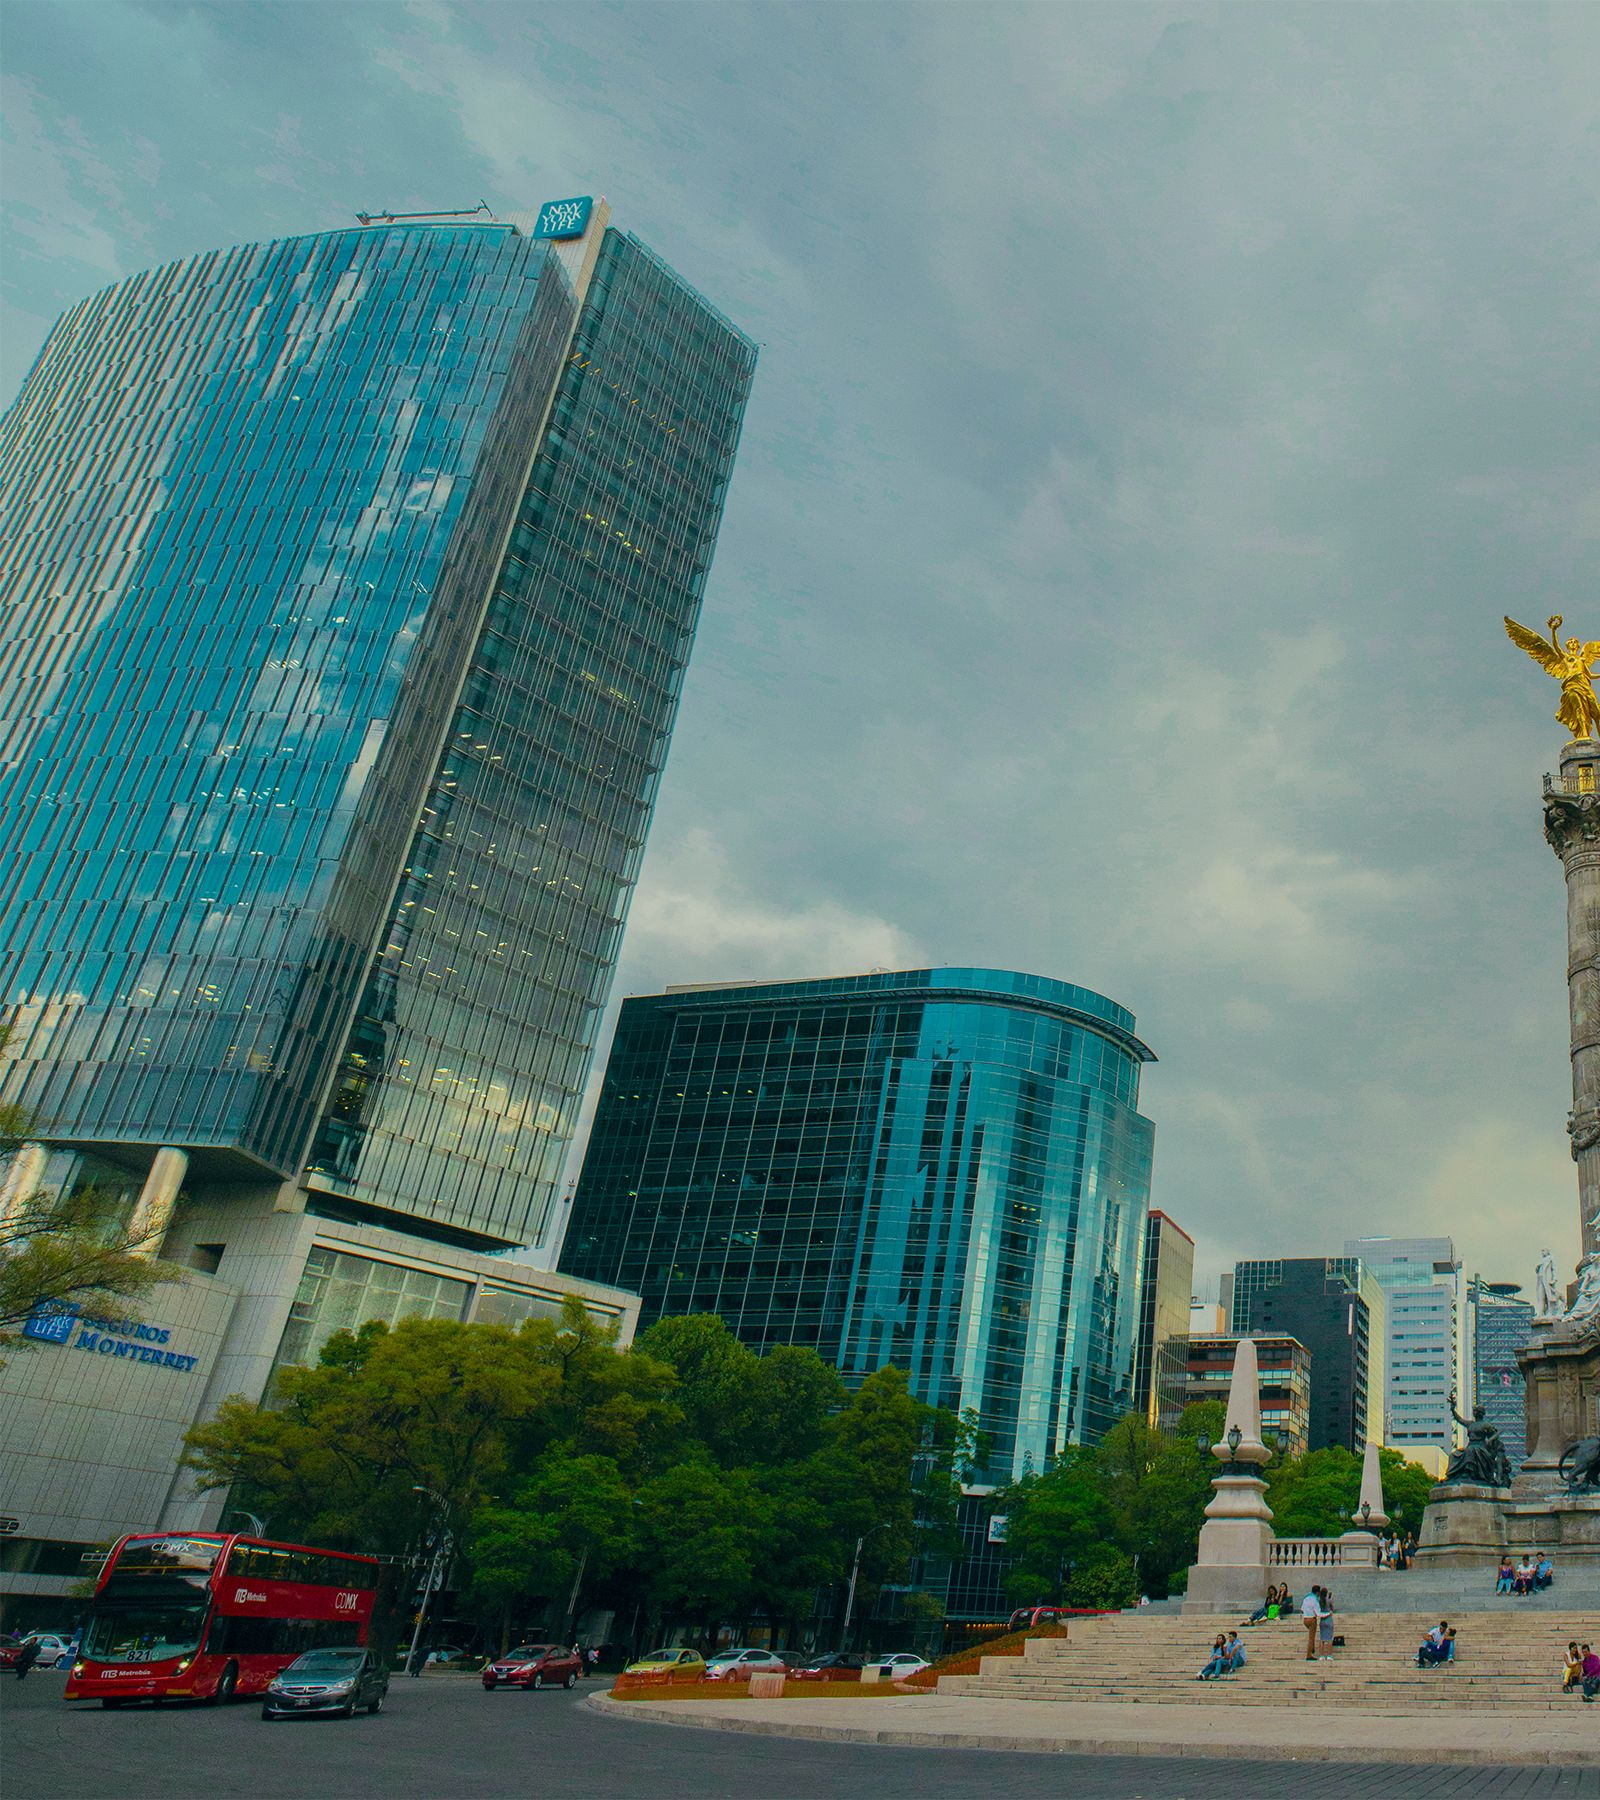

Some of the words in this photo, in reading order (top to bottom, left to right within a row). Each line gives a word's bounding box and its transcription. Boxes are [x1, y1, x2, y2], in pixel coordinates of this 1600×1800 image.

[549, 201, 583, 215] NEW
[542, 209, 582, 223] YORK
[543, 219, 576, 233] LIFE
[34, 1319, 63, 1338] LIFE
[74, 1330, 199, 1371] MONTERREY
[151, 1542, 192, 1551] CDMX
[335, 1592, 359, 1610] CDMX
[127, 1650, 151, 1661] 821
